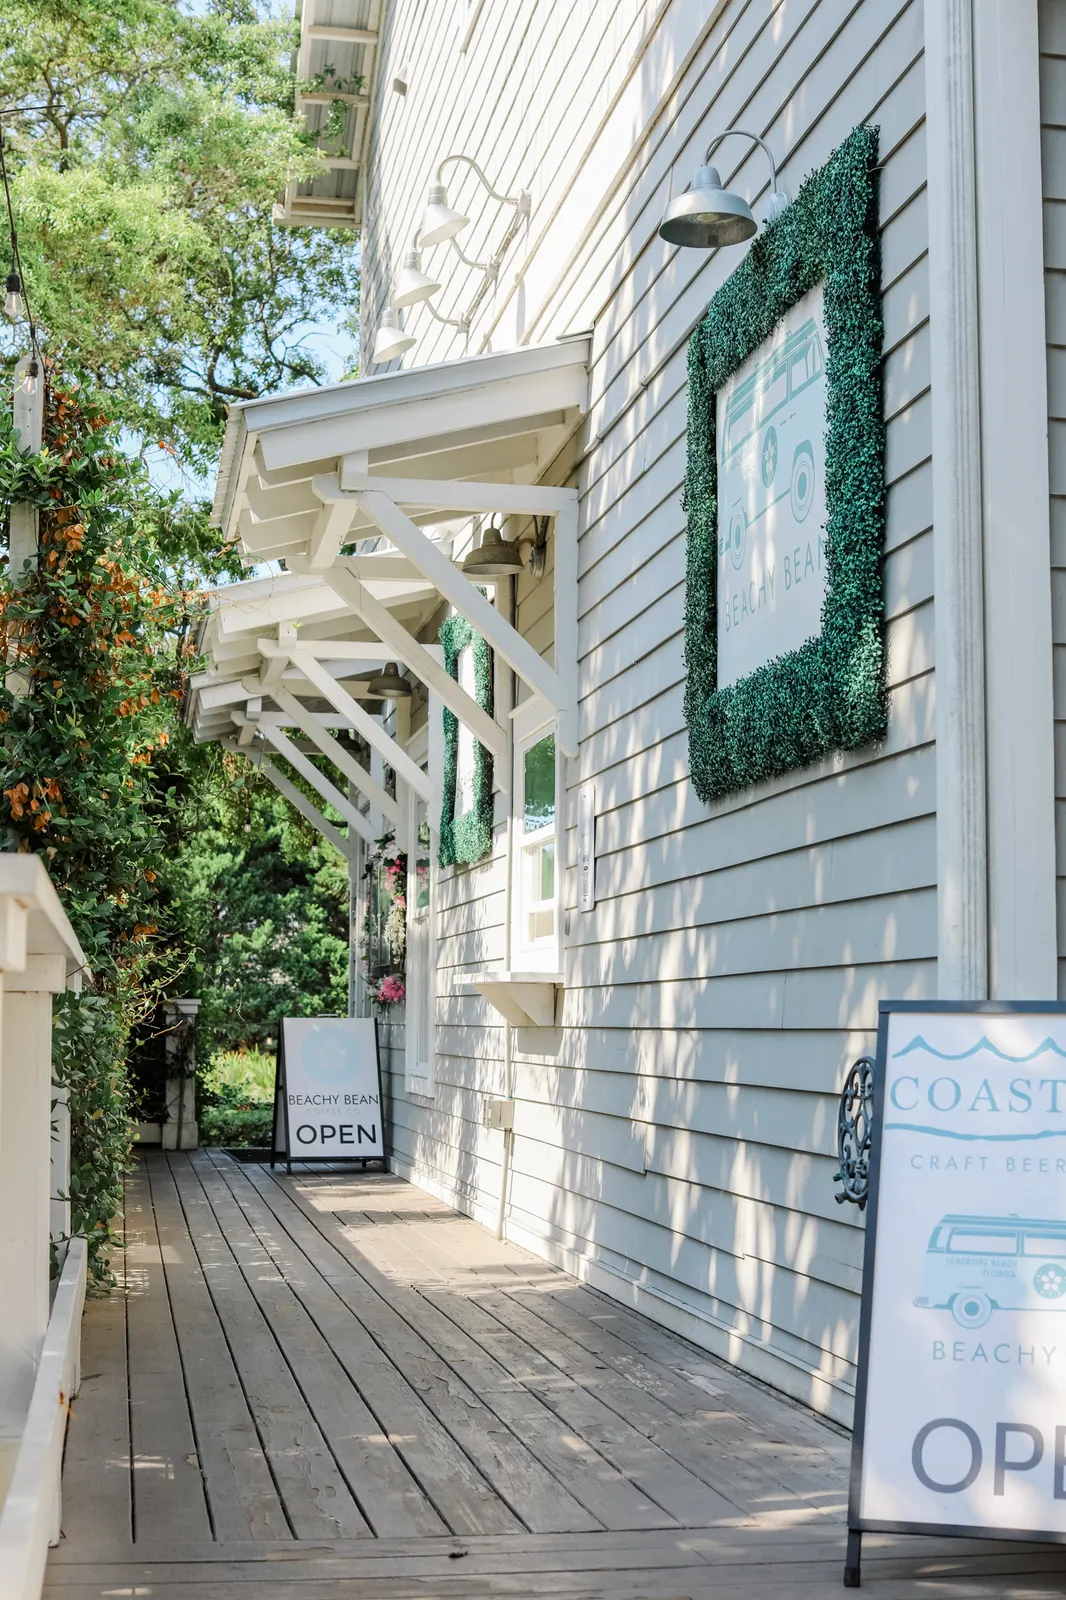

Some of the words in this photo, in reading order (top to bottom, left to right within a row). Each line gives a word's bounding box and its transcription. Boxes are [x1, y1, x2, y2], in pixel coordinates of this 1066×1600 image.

[725, 564, 775, 632] BEACHY
[289, 1095, 339, 1105] BEACHY
[344, 1094, 379, 1105] BEAN
[890, 1076, 1066, 1113] COAST
[296, 1124, 377, 1145] OPEN
[910, 1155, 988, 1171] CRAFT
[1006, 1157, 1066, 1173] BEER
[933, 1341, 1056, 1366] BEACHY
[912, 1417, 1066, 1500] OP
